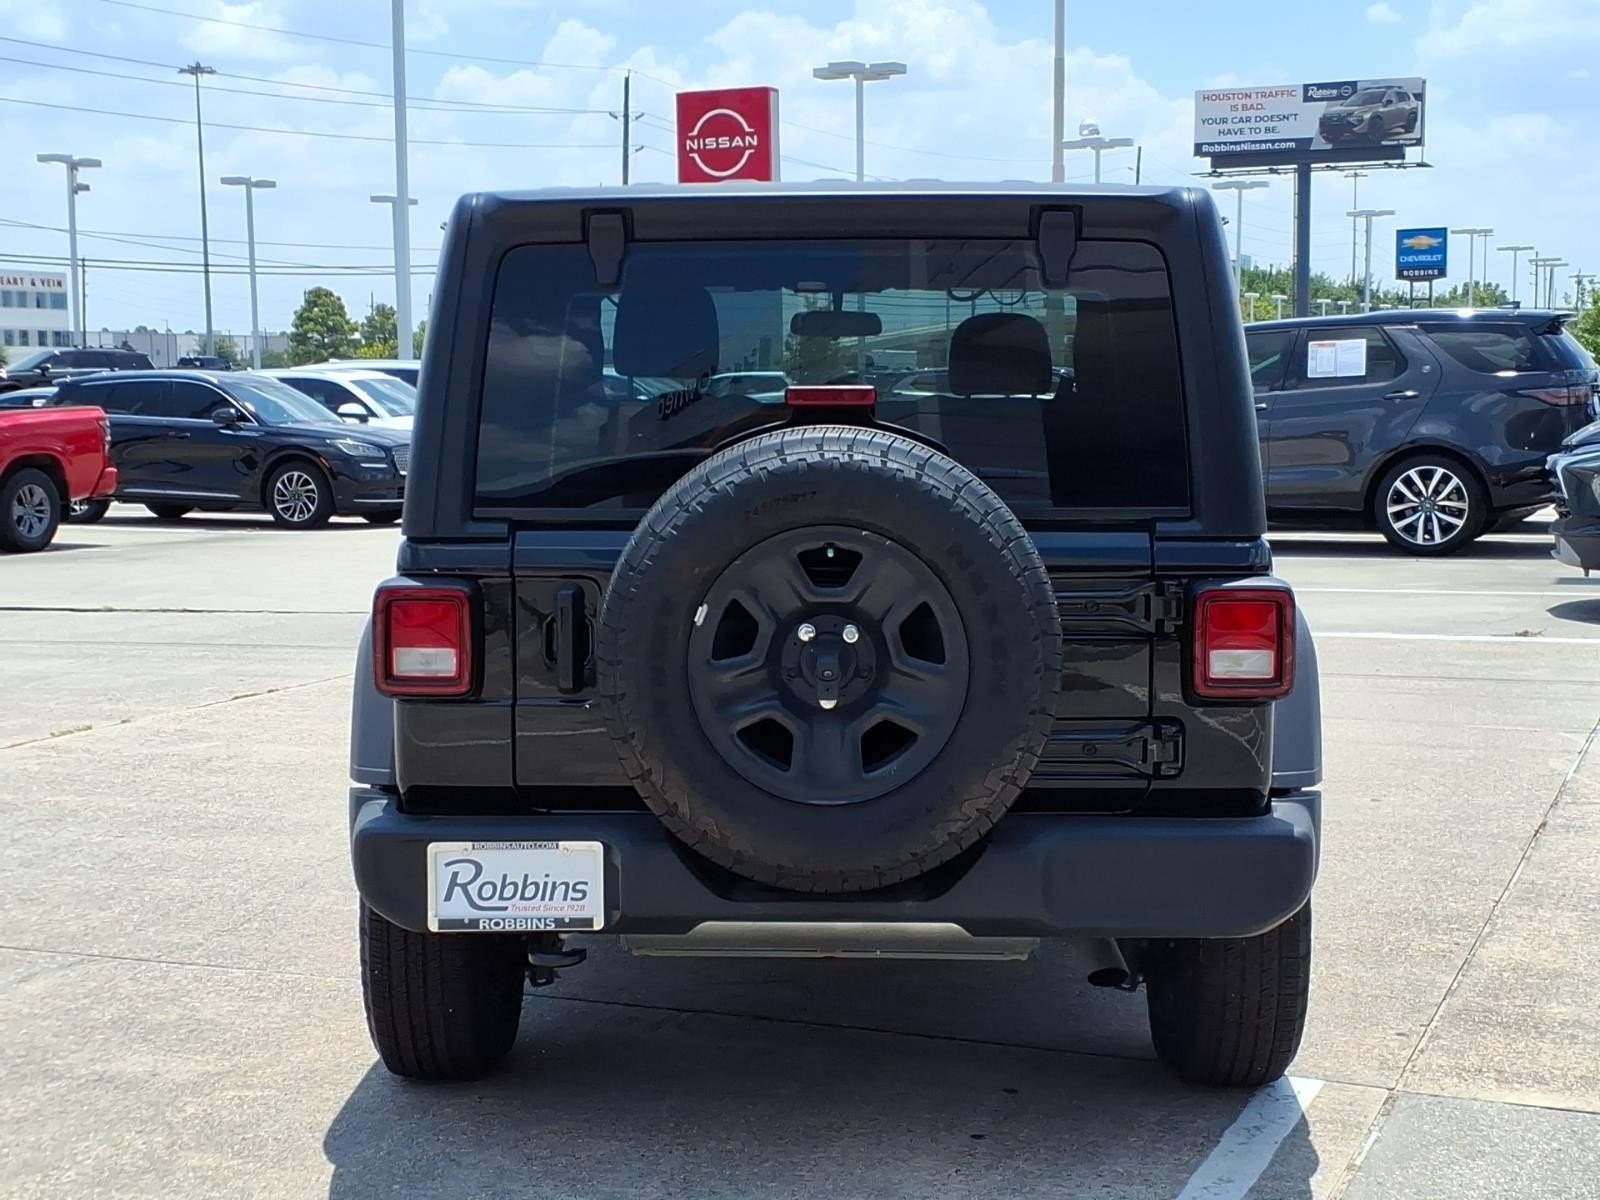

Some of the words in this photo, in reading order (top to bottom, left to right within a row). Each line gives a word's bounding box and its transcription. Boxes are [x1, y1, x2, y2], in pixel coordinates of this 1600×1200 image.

[1202, 91, 1252, 102] HOUSTON
[1254, 89, 1297, 99] TRAFFIC
[1230, 104, 1239, 112] IS
[1241, 103, 1266, 112] BAD.
[1201, 117, 1228, 126] YOUR
[1231, 115, 1252, 125] CAR
[1254, 113, 1299, 124] DOESN'T
[1218, 128, 1246, 137] HAVE
[1248, 126, 1262, 135] TO
[1264, 126, 1280, 134] BE.
[686, 134, 758, 151] NISSAN
[1201, 142, 1296, 153] RobbinsNissan.com
[31, 278, 36, 287] &
[40, 278, 63, 288] VEIN
[474, 841, 557, 850] ROBBINSAUTO.COM
[443, 858, 589, 911] Robbins
[511, 903, 541, 912] Trusted
[543, 903, 565, 912] Since
[566, 904, 586, 912] 1928
[479, 917, 556, 930] ROBBINS
